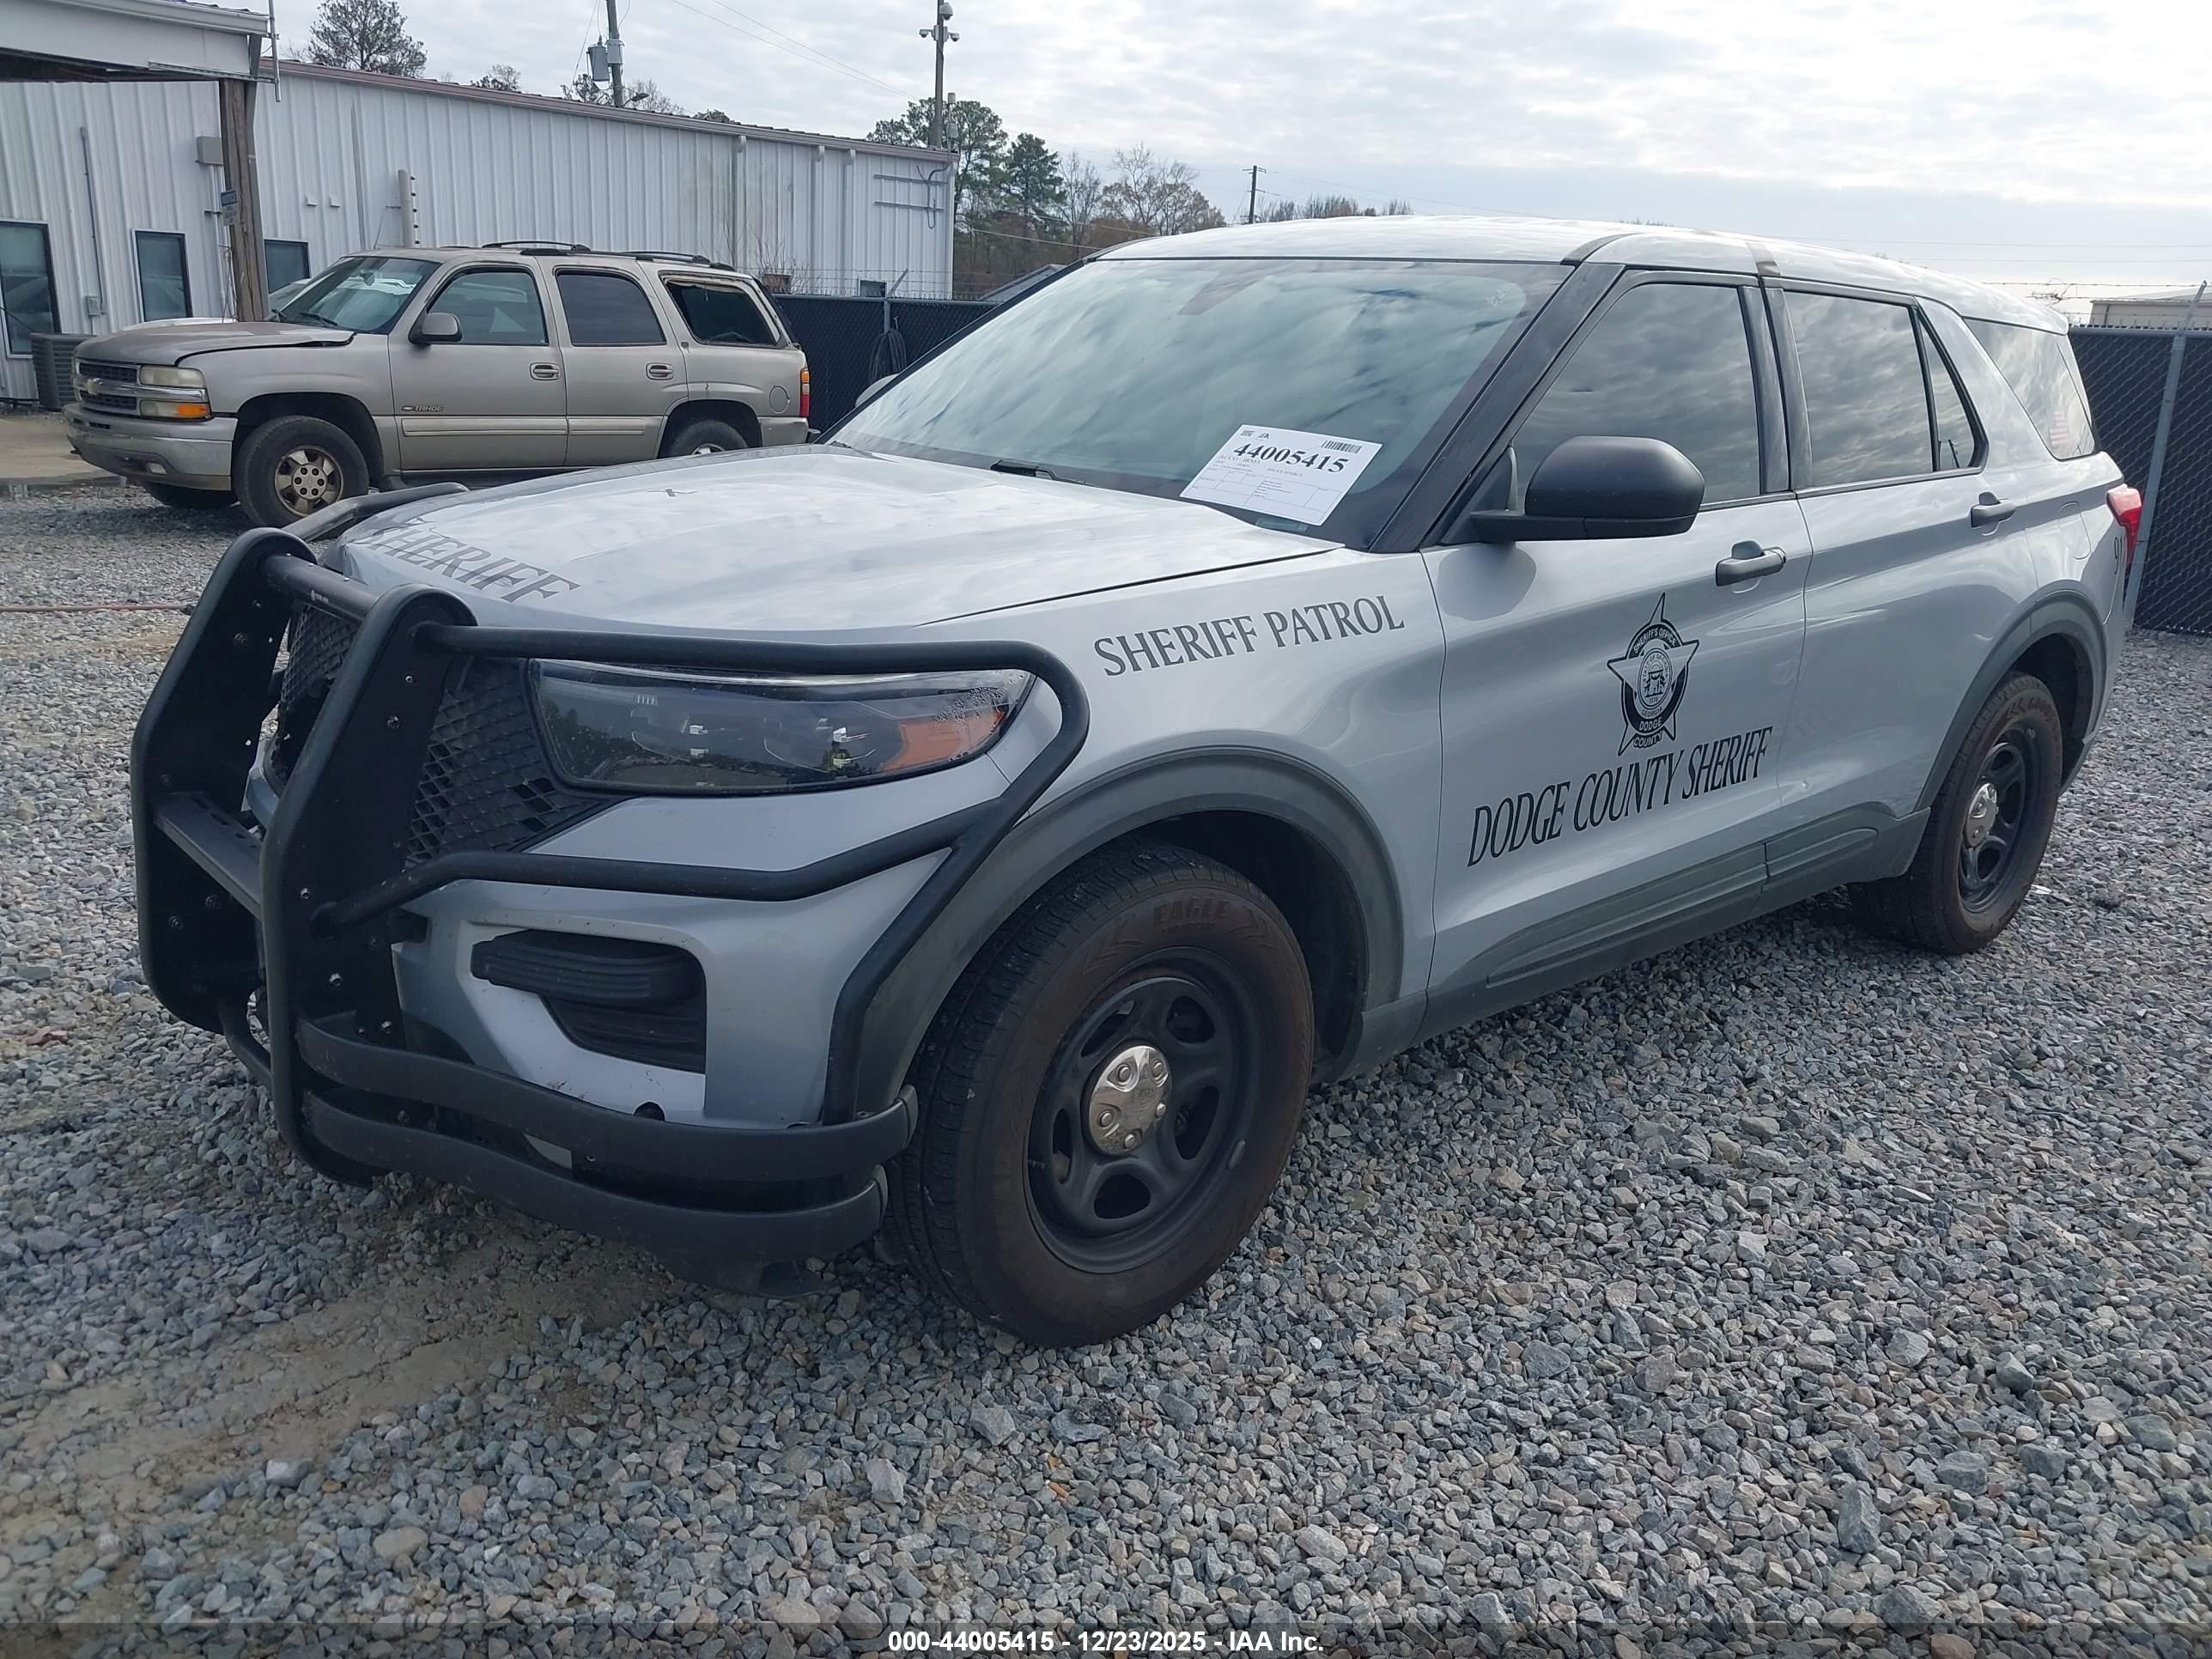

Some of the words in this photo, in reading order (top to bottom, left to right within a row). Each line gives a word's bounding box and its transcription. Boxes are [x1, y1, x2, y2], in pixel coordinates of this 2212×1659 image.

[1234, 444, 1351, 473] 44005415
[1094, 615, 1258, 677] SHERIFF
[1263, 595, 1405, 648] PATROL
[1658, 628, 1677, 647] OFFICE
[1638, 716, 1662, 732] DODGE
[1641, 706, 1663, 718] GEORGIA
[1633, 730, 1663, 749] COUNTY
[1467, 781, 1571, 867] DODGE
[1573, 749, 1685, 832] COUNTY
[1681, 726, 1773, 799] SHERIFF
[1154, 896, 1230, 928] EAGLE
